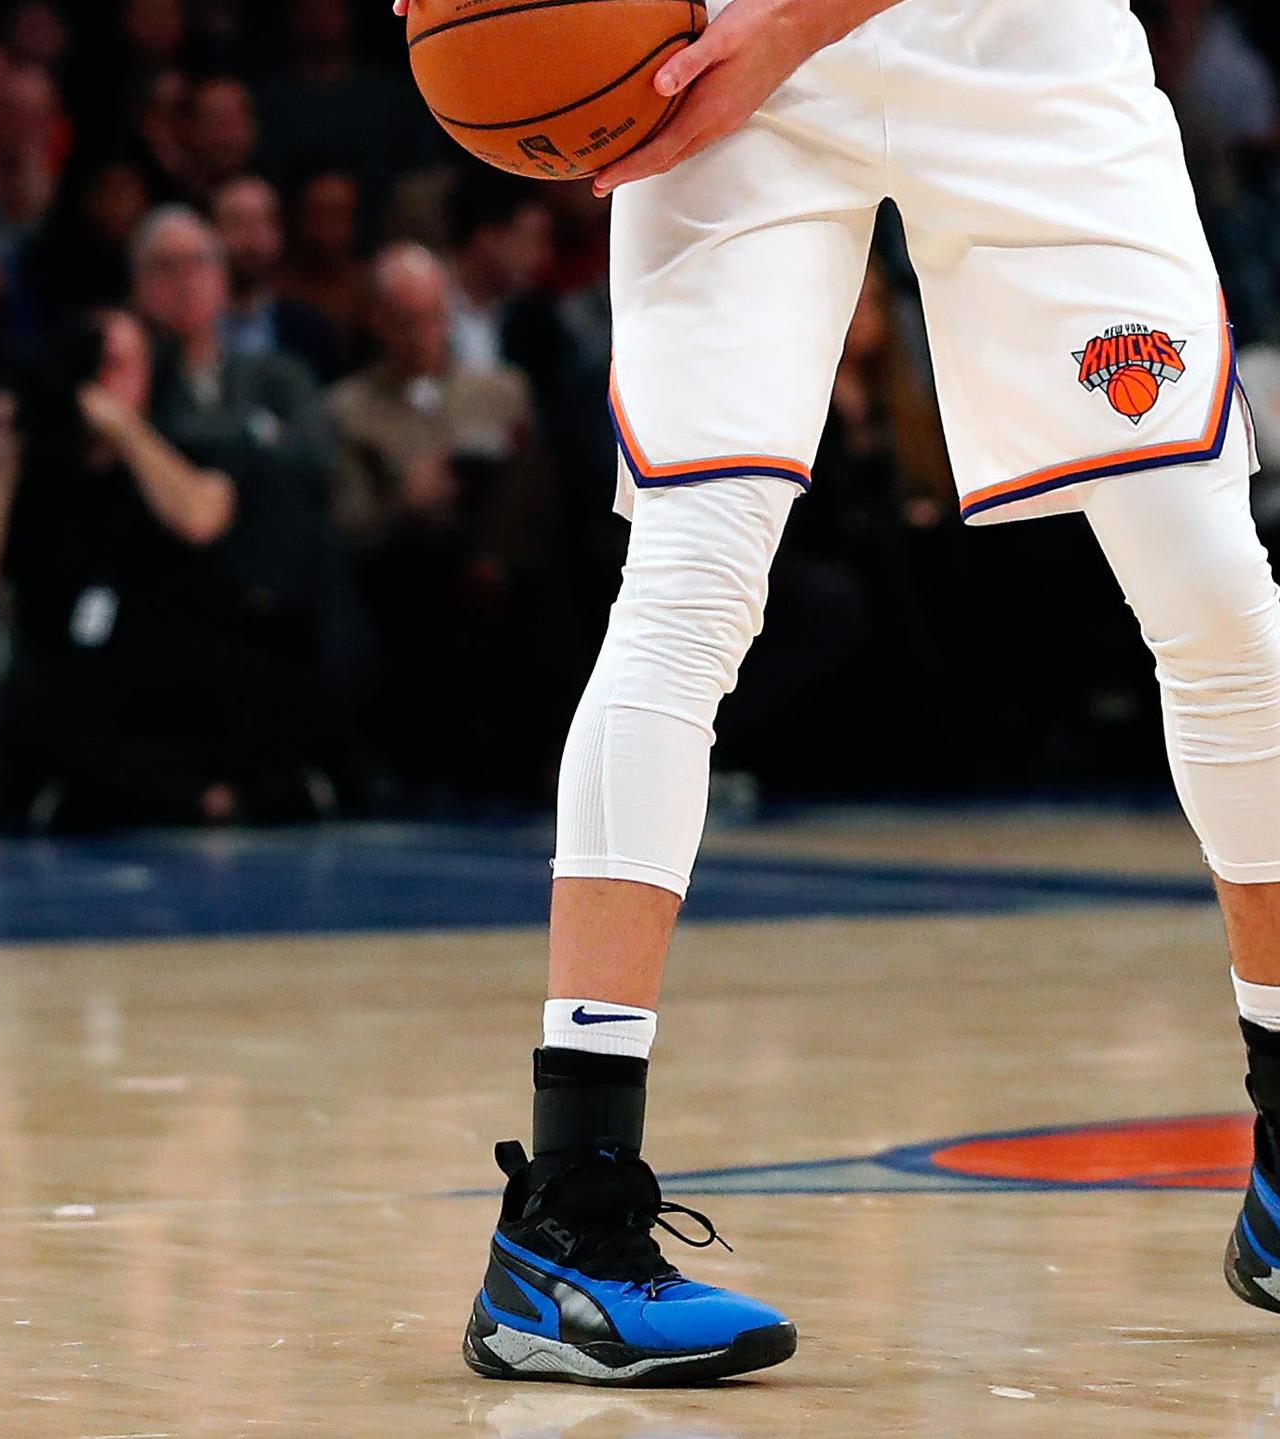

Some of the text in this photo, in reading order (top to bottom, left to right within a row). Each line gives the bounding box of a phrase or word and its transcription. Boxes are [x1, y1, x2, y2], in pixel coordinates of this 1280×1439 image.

[1104, 323, 1149, 338] NEW YORK
[1078, 330, 1186, 383] KNICKS
